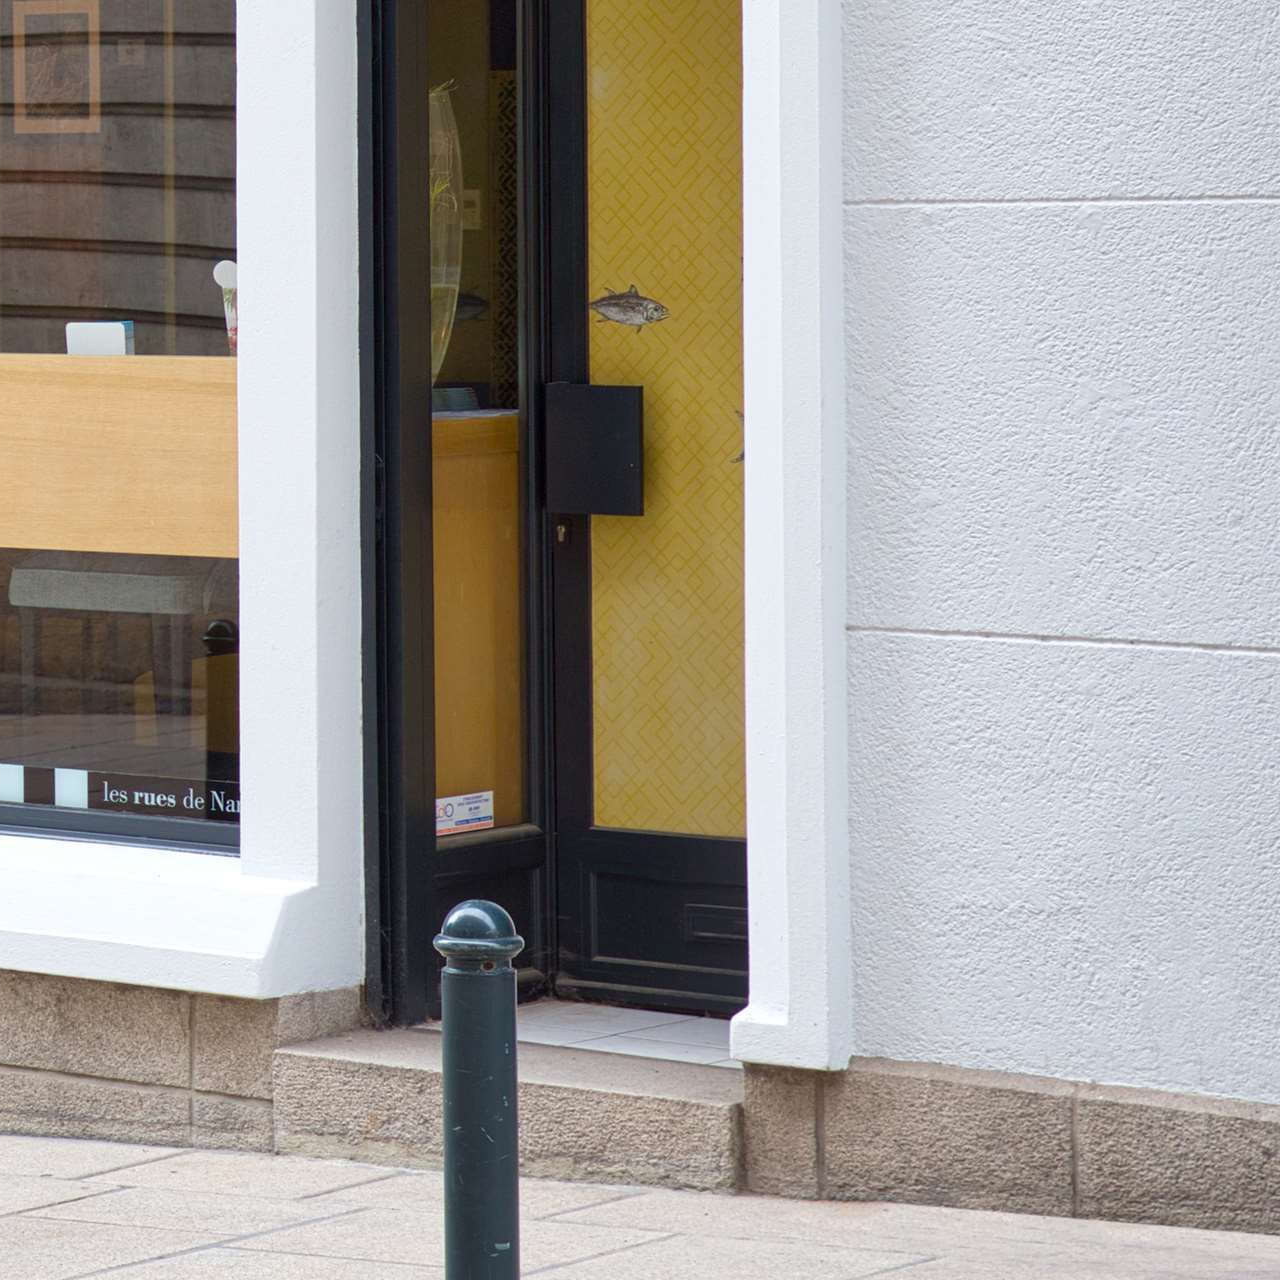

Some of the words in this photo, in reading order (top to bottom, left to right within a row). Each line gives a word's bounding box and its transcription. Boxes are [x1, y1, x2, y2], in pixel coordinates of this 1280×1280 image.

[103, 781, 128, 803] les
[133, 791, 177, 807] rues
[183, 788, 205, 810] de
